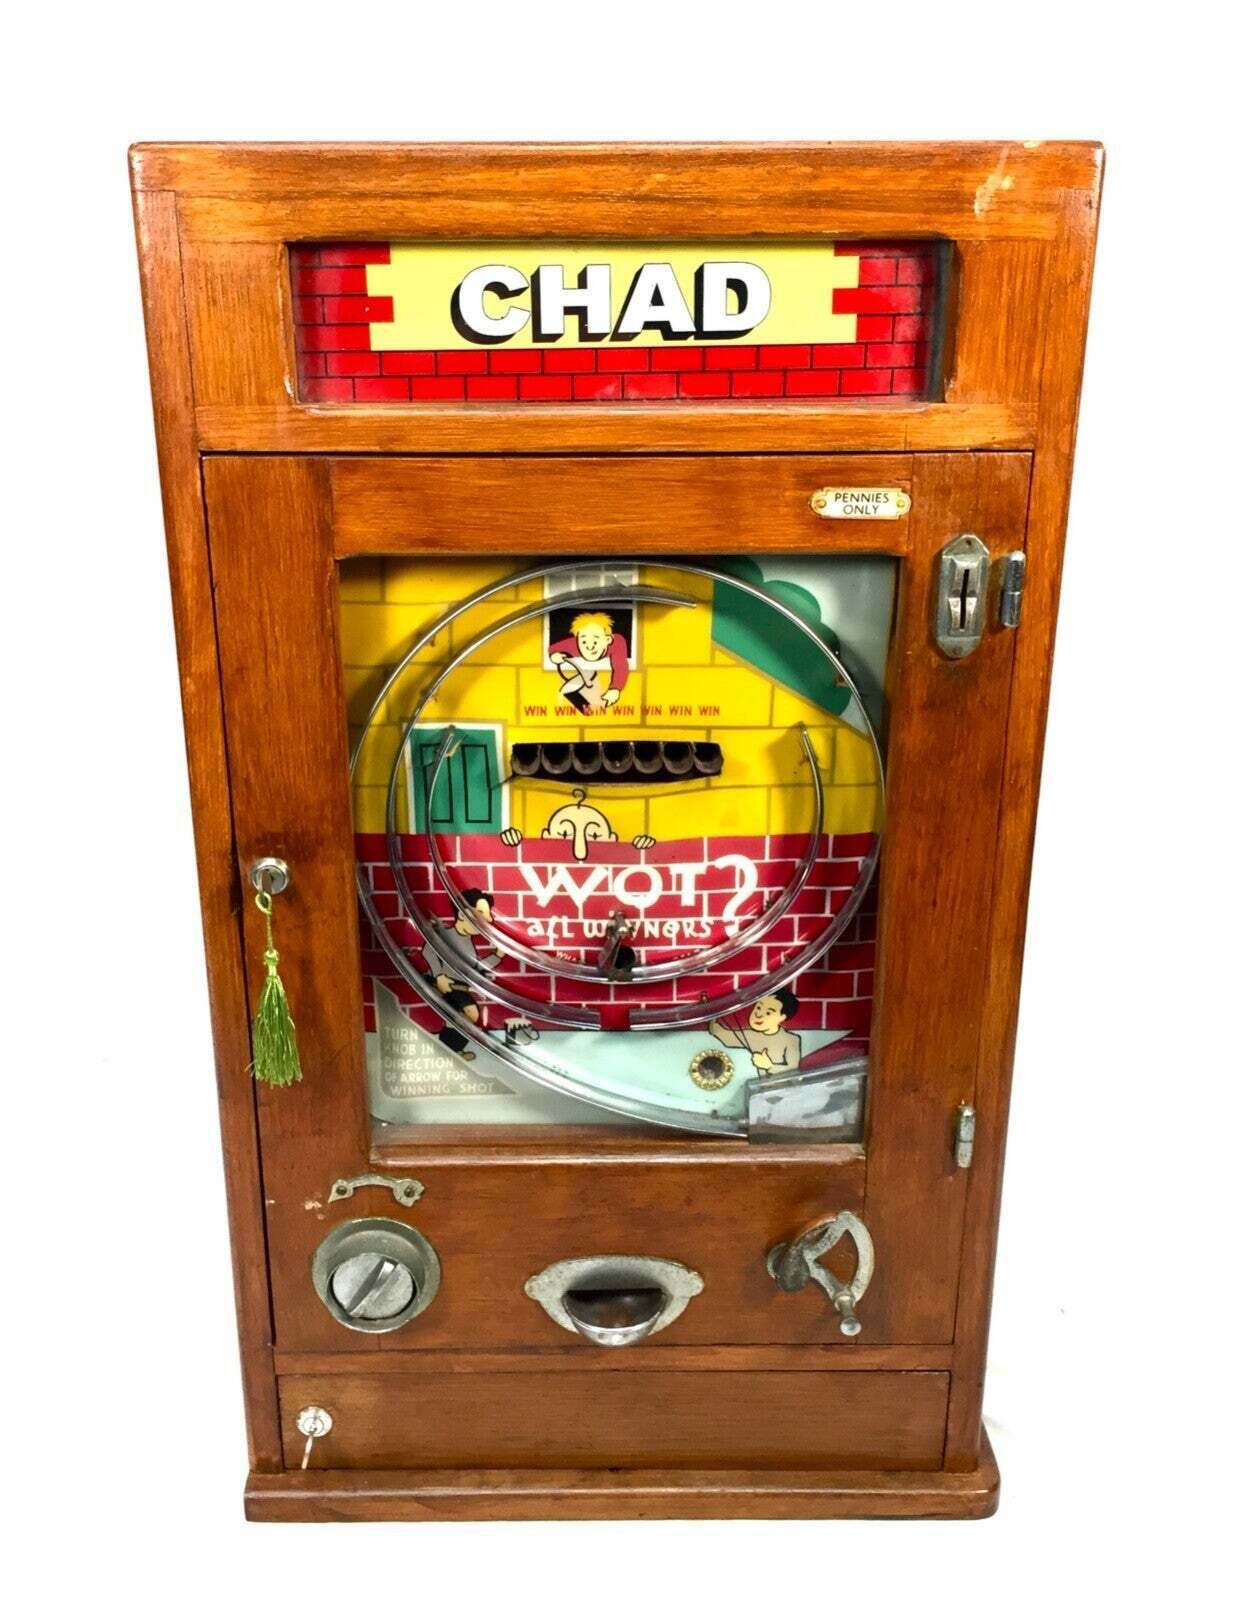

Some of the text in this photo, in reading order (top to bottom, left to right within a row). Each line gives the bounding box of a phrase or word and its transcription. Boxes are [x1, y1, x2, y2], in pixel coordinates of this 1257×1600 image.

[451, 262, 771, 345] CHAD
[834, 493, 889, 503] PENNIES
[843, 505, 880, 515] ONLY
[525, 705, 547, 717] WIN
[555, 705, 577, 717] WIN
[612, 705, 634, 717] WIN
[641, 705, 662, 717] WIN
[669, 705, 692, 717] WIN
[699, 705, 720, 717] WIN
[518, 854, 757, 936] WOT?
[383, 1025, 419, 1042] TURN
[384, 1042, 434, 1056] KNOB IN
[384, 1056, 455, 1071] DIRECTION
[384, 1070, 469, 1083] OF ARROW FOR
[390, 1082, 495, 1097] WINNING SHOT
